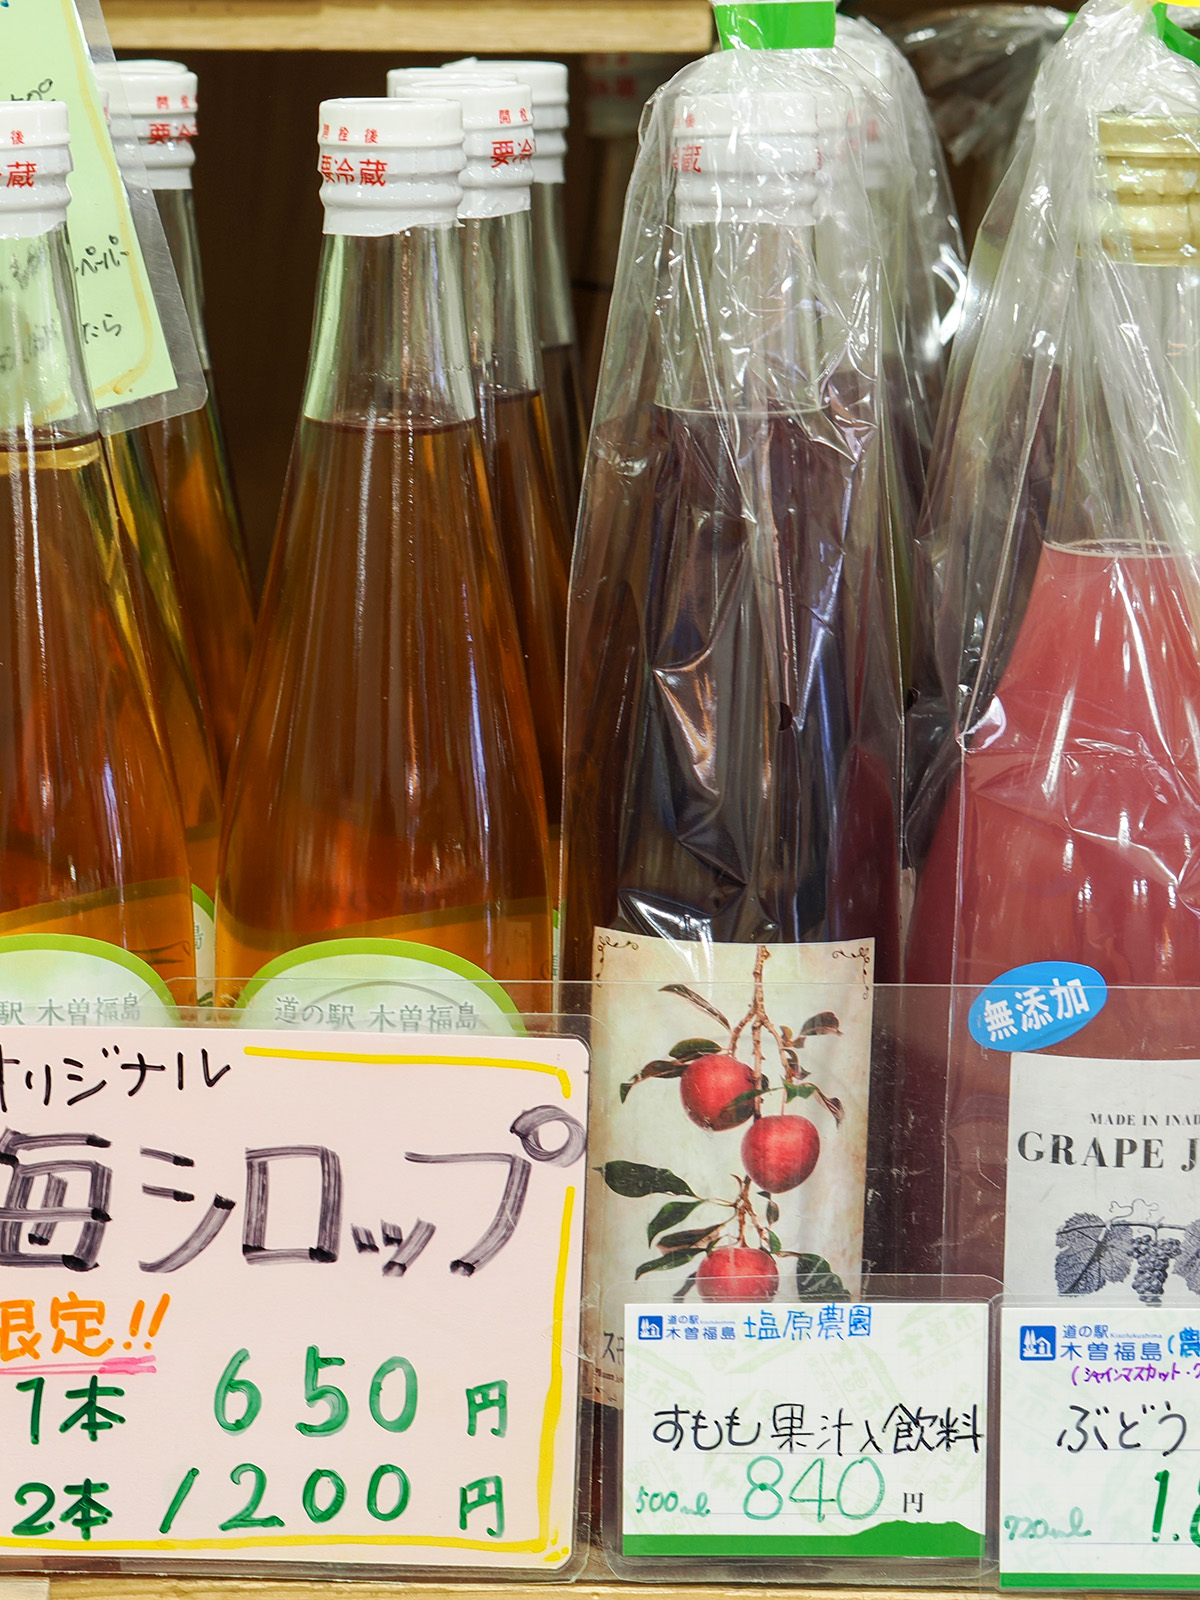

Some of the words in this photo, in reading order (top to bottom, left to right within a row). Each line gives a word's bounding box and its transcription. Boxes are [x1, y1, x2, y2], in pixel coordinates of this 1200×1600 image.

[491, 139, 537, 168] 要冷
[37, 992, 141, 1027] 木曽福島
[274, 996, 356, 1030] 道の駅
[368, 1001, 480, 1032] 木曽福島
[983, 977, 1091, 1042] 無添加
[1089, 1112, 1136, 1126] MADE
[1143, 1114, 1158, 1126] IN
[1017, 1130, 1164, 1169] GRAPE
[666, 1326, 736, 1341] 木曽福島
[743, 1302, 872, 1341] 塩原農園
[667, 1314, 699, 1325] 道の駅
[1062, 1324, 1109, 1339] 道の駅
[1060, 1341, 1163, 1362] 木曽福島
[15, 1374, 126, 1445] 1本
[212, 1344, 419, 1437] 650
[466, 1379, 509, 1438] 円
[1056, 1401, 1187, 1457] ぶどう
[11, 1477, 113, 1540] 2本
[458, 1475, 504, 1538] 円
[741, 1455, 886, 1523] 840
[903, 1491, 924, 1514] 円
